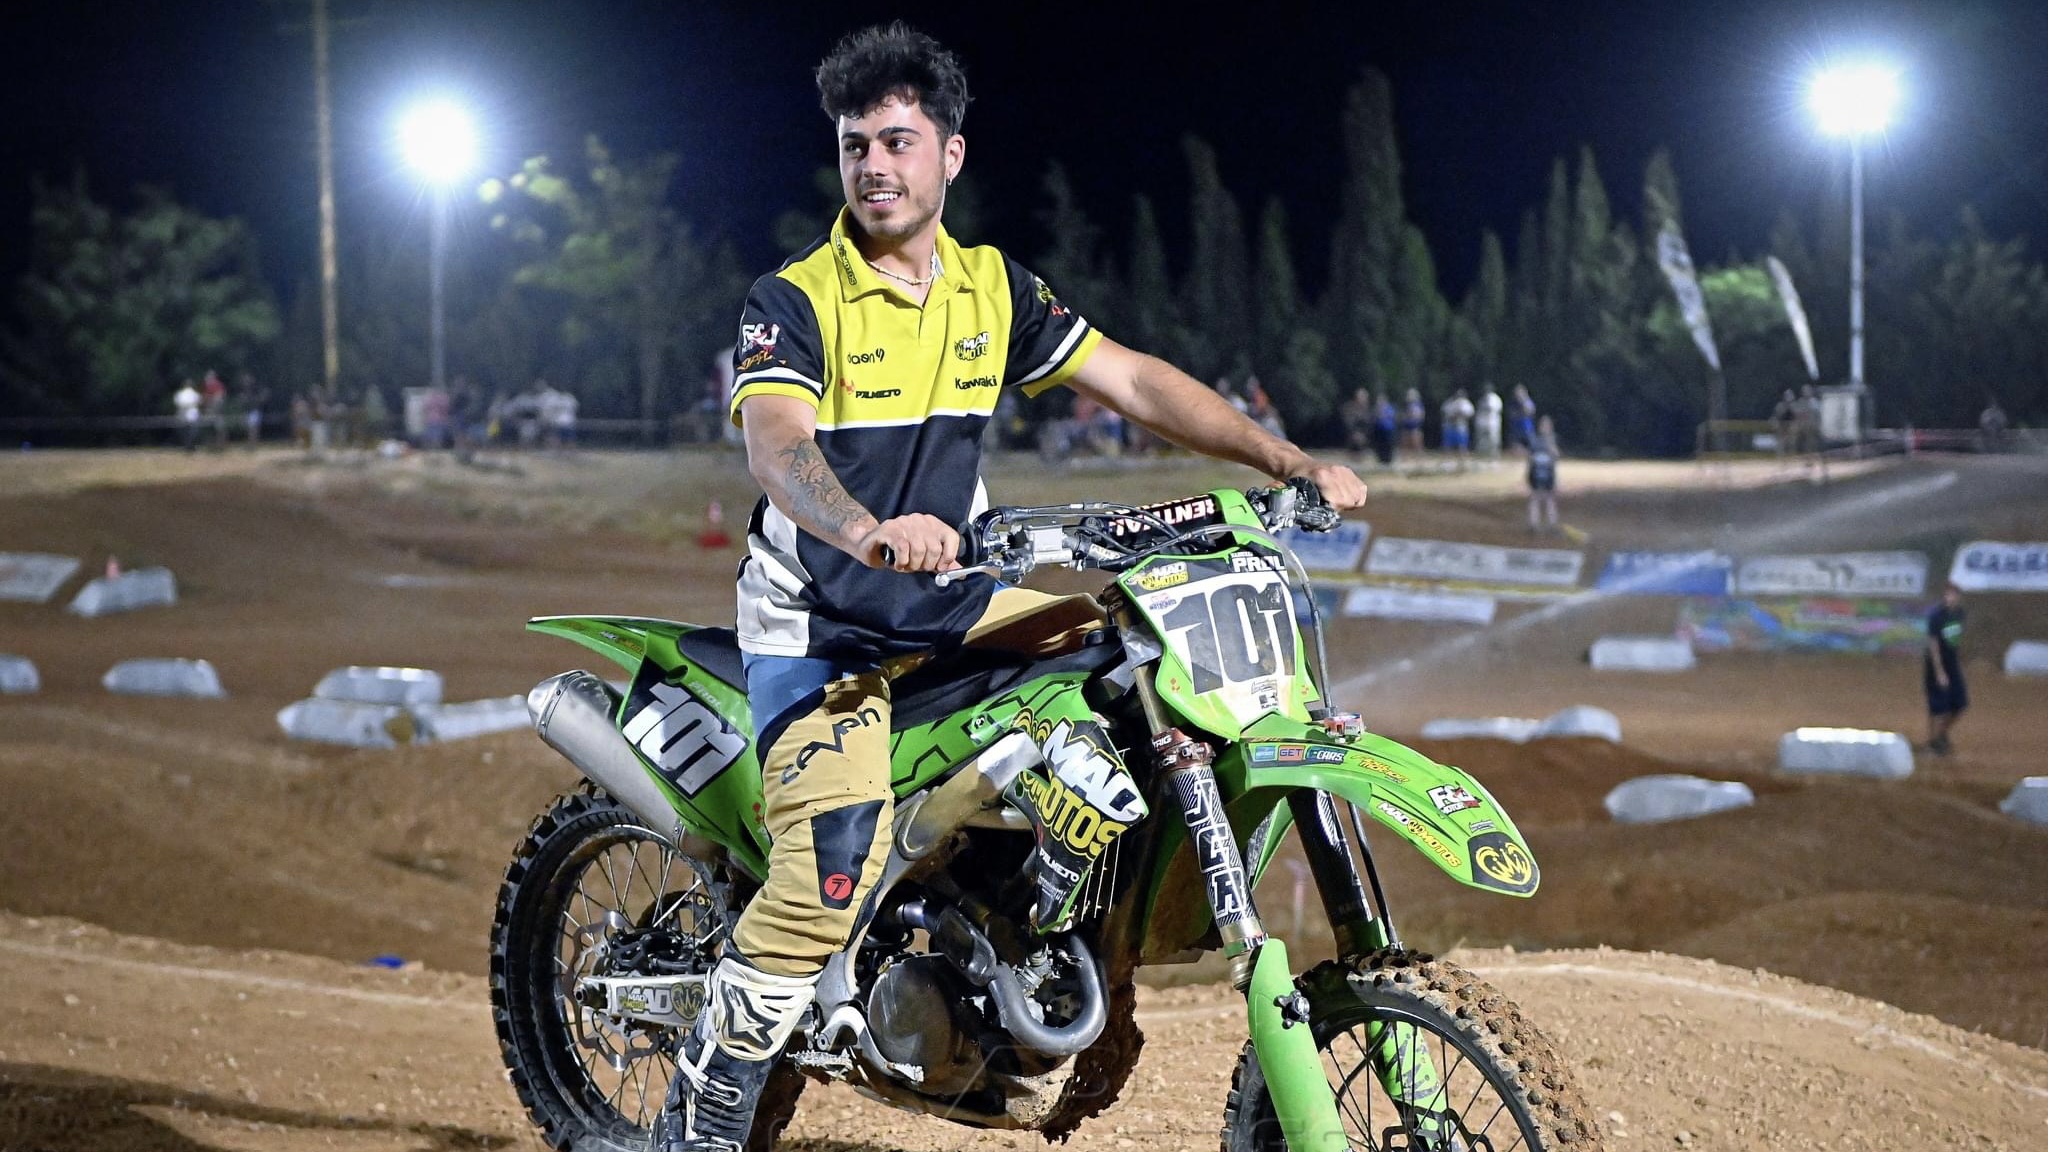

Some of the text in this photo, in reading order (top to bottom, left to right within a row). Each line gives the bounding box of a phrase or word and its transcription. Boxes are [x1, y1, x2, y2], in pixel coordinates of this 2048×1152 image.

[1162, 582, 1297, 695] 101
[621, 681, 750, 797] 101
[1279, 748, 1304, 758] GET
[1377, 802, 1410, 826] MAD
